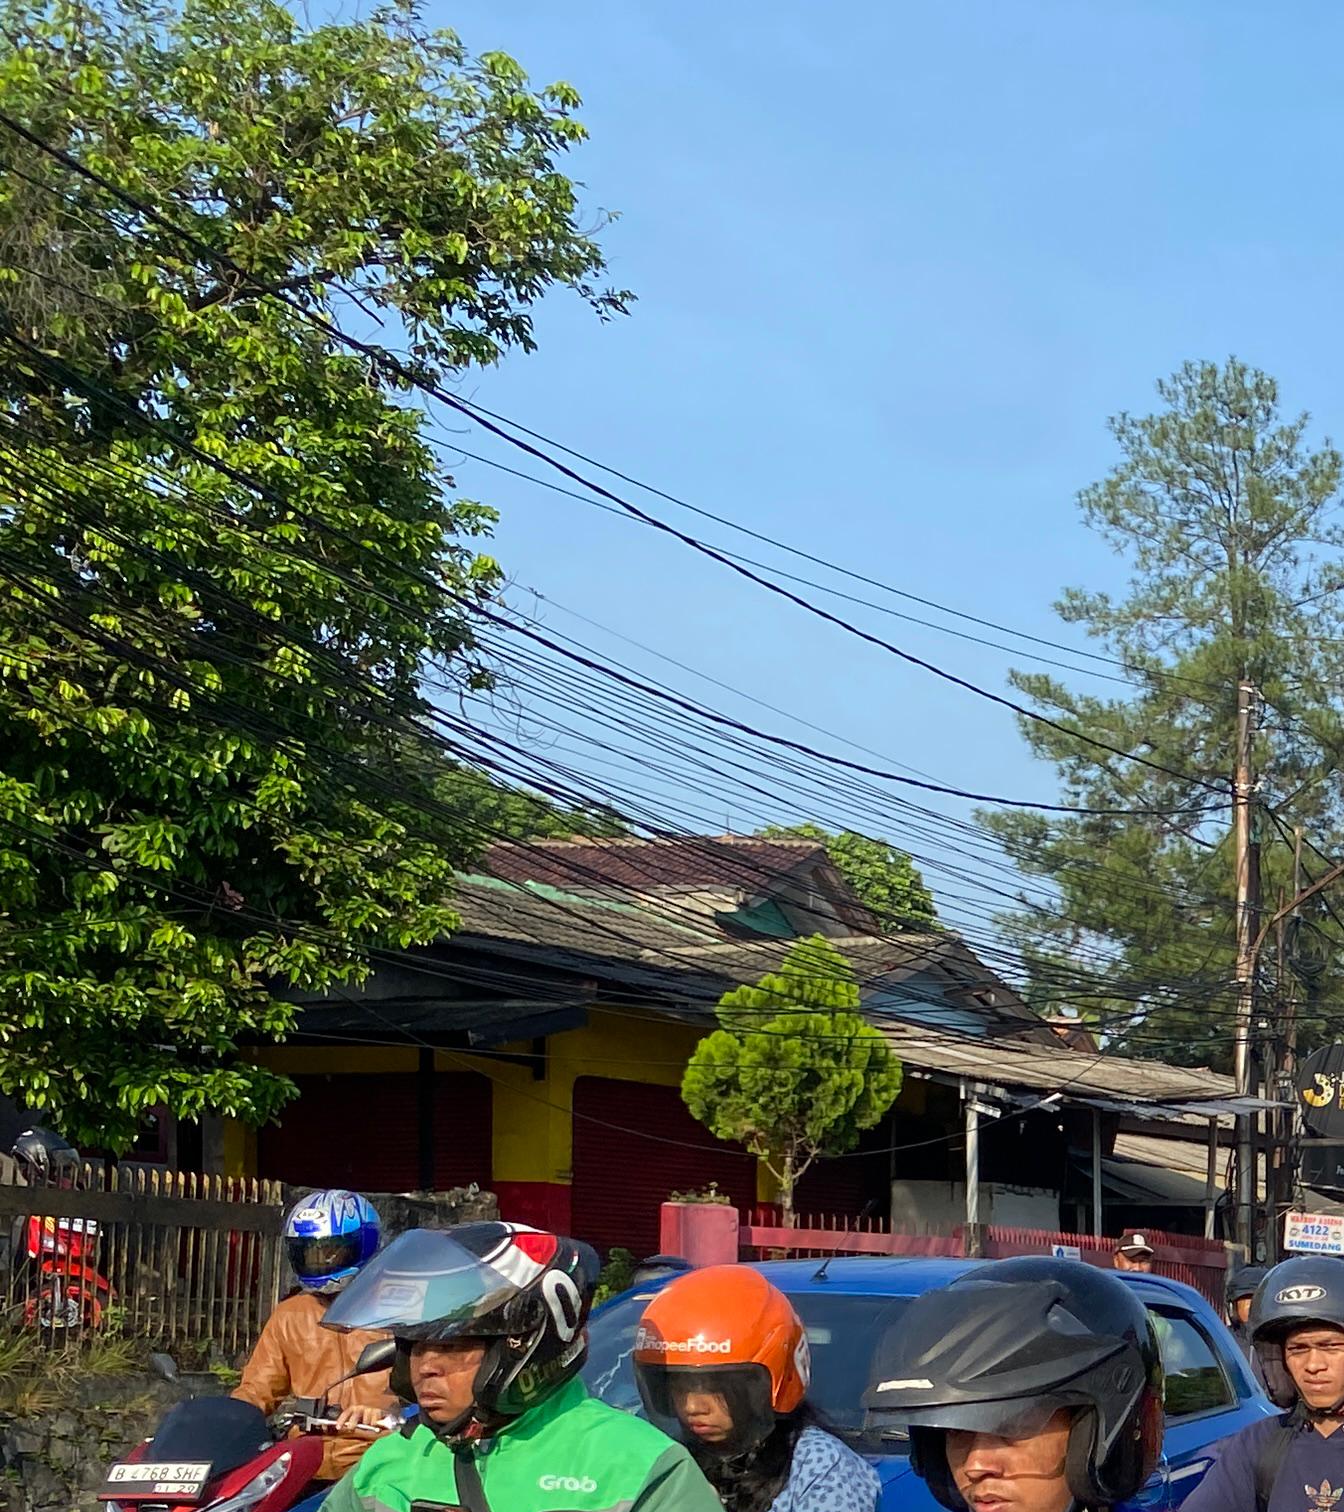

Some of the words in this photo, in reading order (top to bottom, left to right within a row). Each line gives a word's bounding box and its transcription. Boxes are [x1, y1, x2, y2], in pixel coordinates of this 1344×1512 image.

[1302, 1225, 1329, 1236] 4122
[1289, 1239, 1341, 1251] SUMEDANG
[1281, 1288, 1318, 1300] KYT
[115, 1467, 125, 1480] B
[539, 1475, 597, 1493] Grab
